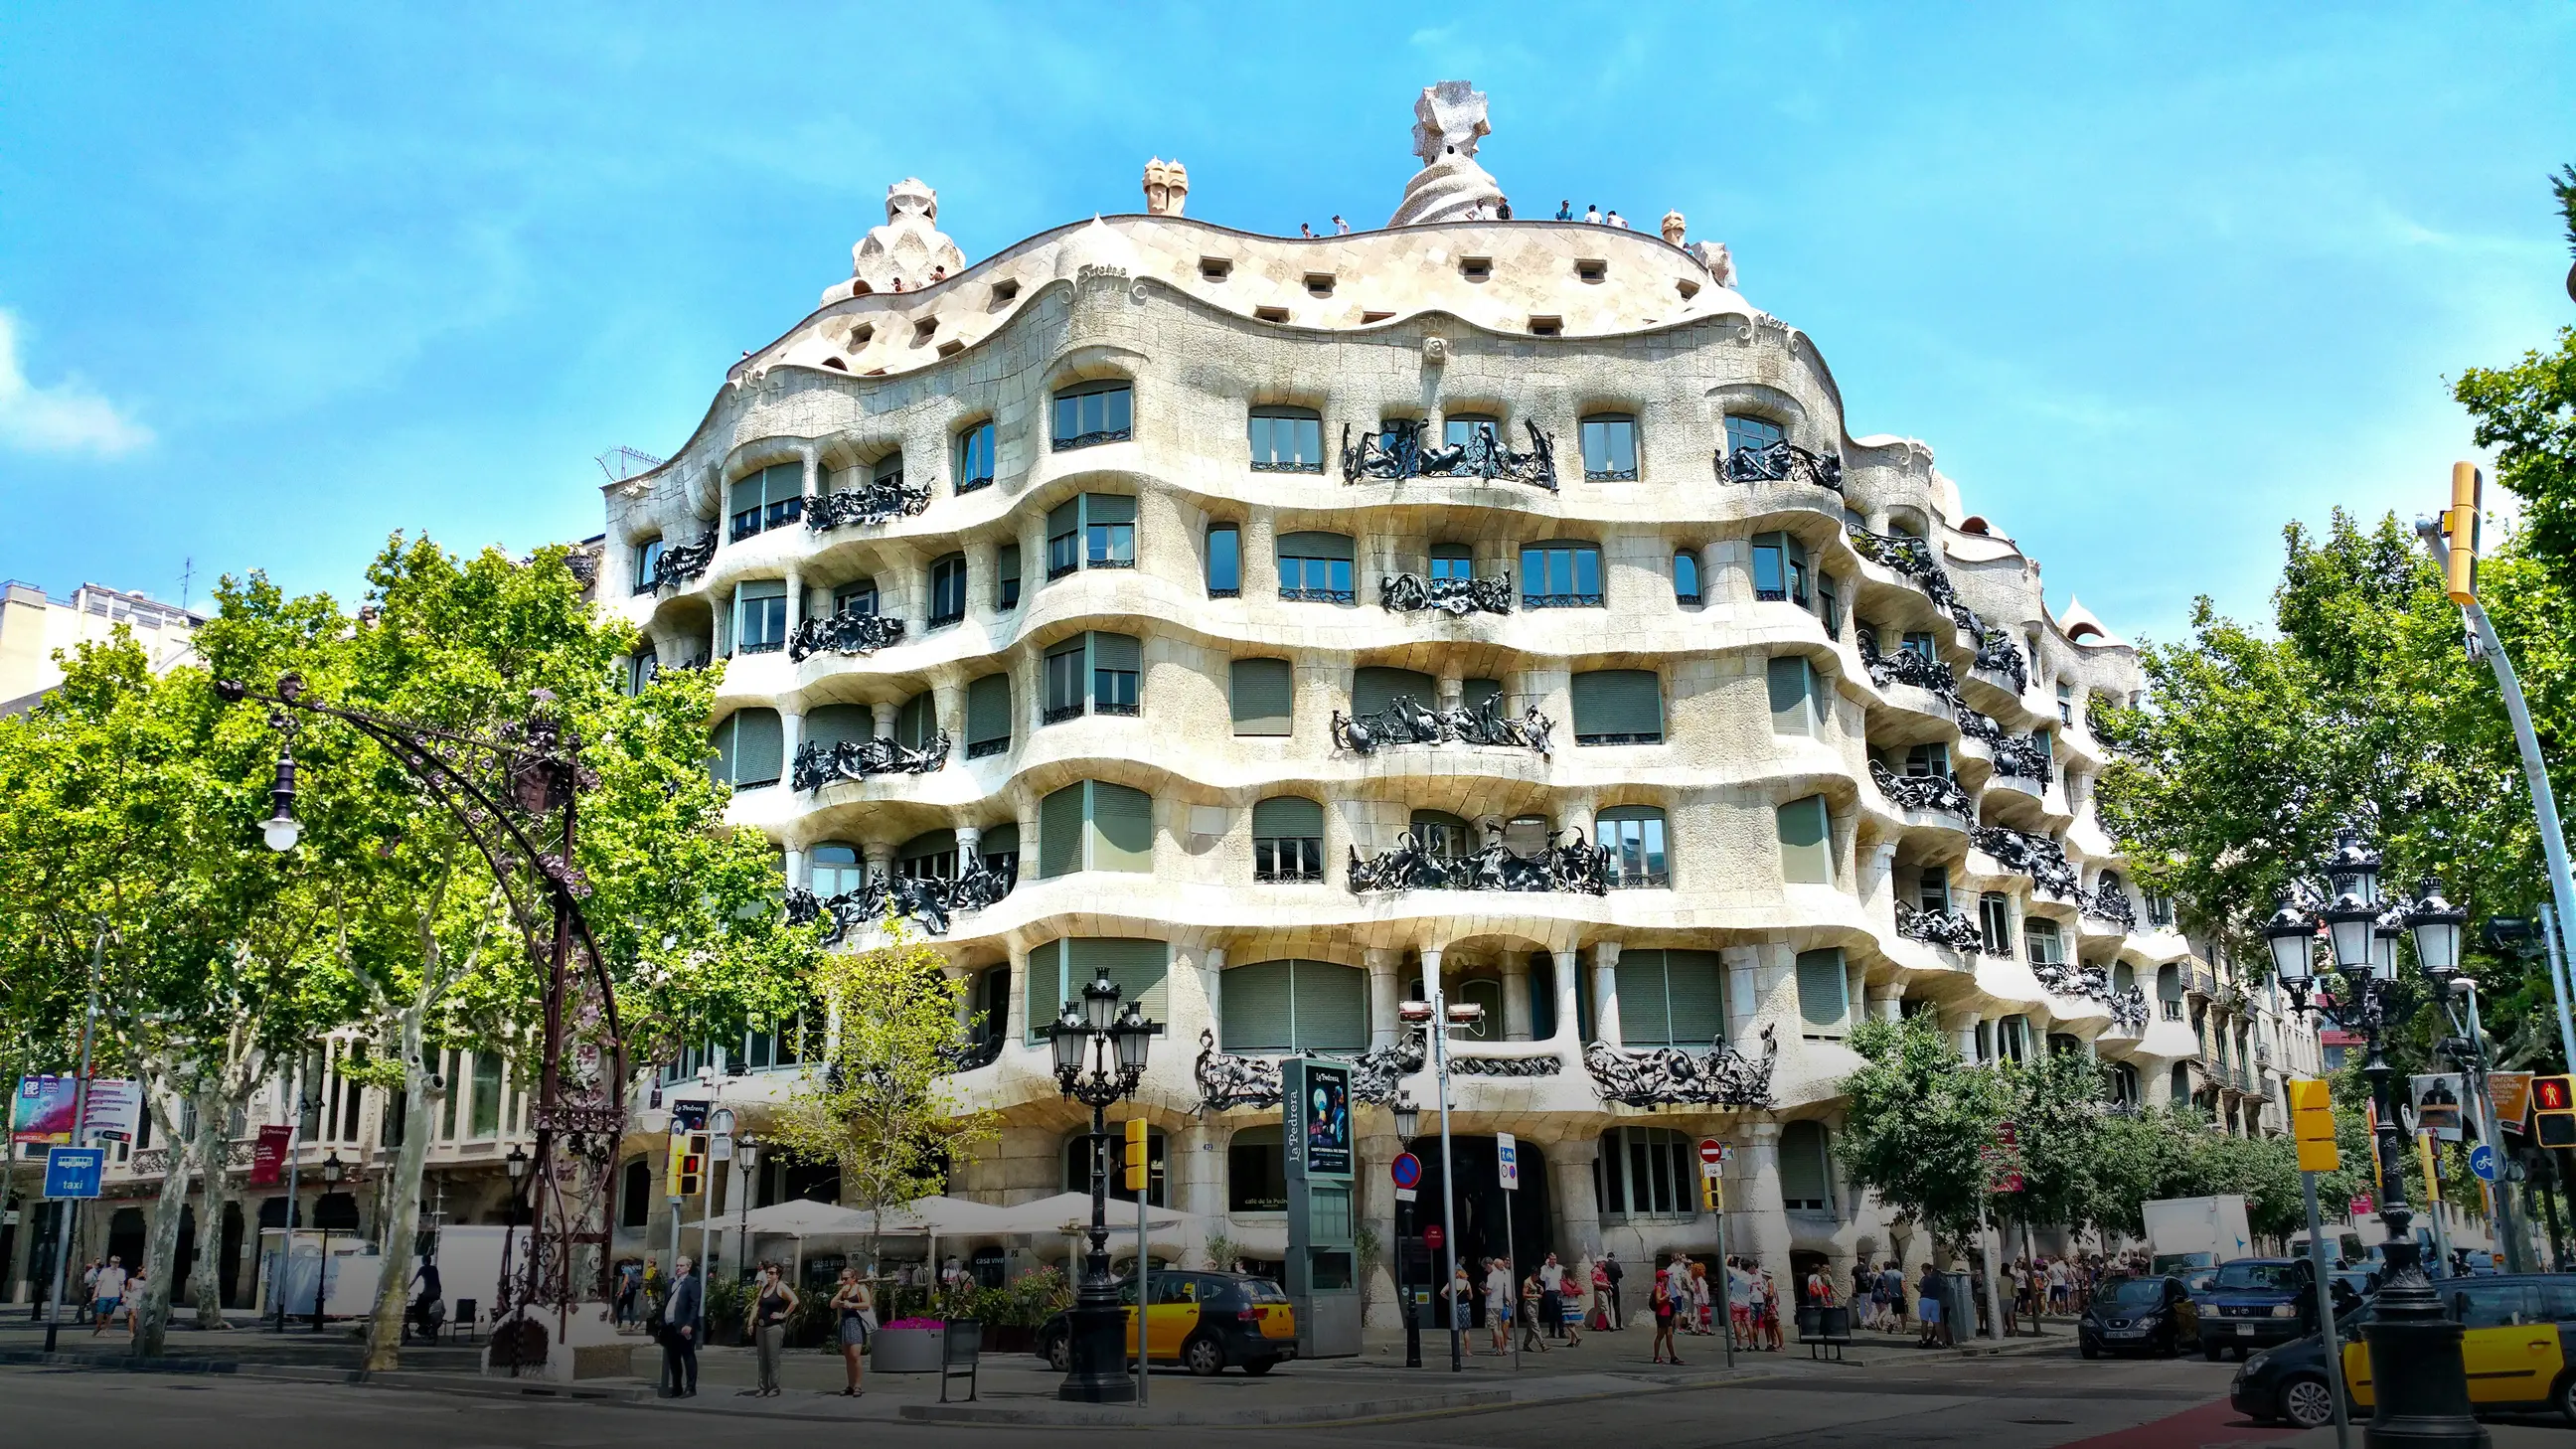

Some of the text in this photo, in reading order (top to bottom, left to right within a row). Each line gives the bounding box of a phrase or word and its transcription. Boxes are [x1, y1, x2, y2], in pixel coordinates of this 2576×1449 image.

[1288, 1089, 1300, 1163] La Pedrera
[63, 1180, 83, 1190] taxi
